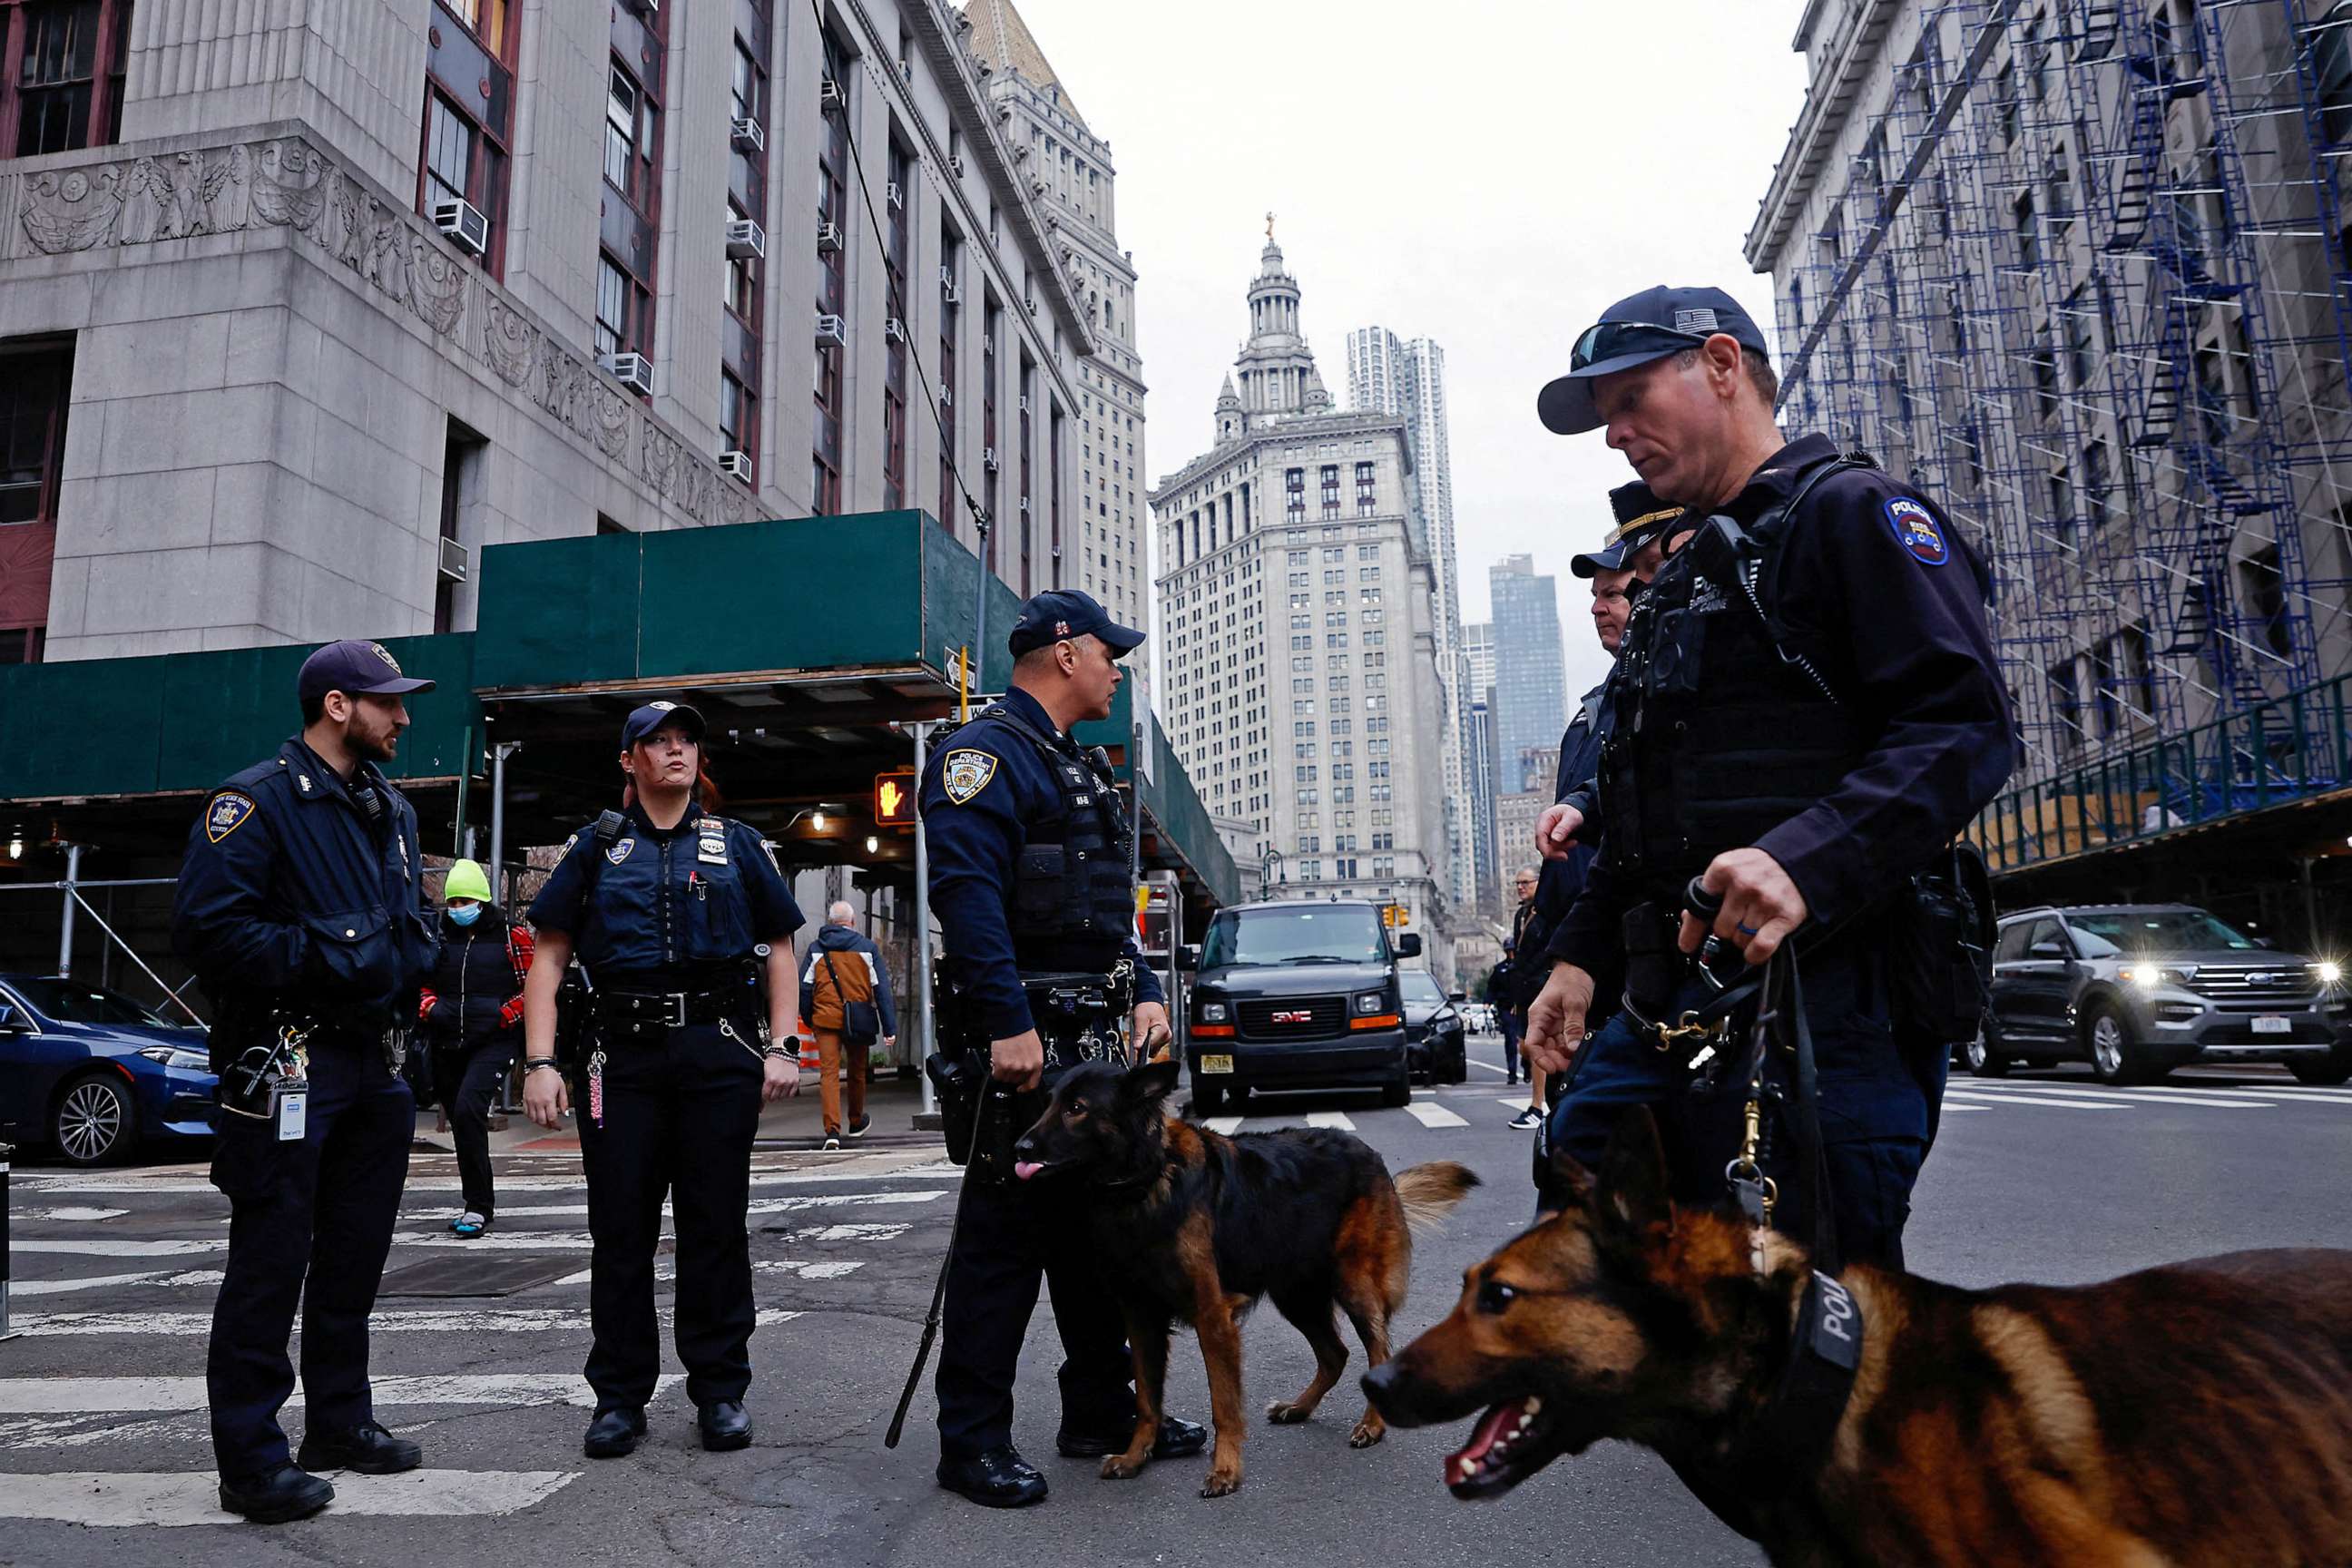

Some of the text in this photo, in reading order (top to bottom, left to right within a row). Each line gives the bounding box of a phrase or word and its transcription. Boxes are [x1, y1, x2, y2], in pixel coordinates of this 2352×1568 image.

[959, 752, 984, 761] POLICE
[949, 758, 990, 771] DEPARTMENT
[949, 785, 956, 795] OF
[963, 773, 990, 799] NEW YORK
[1271, 1010, 1312, 1023] GMC
